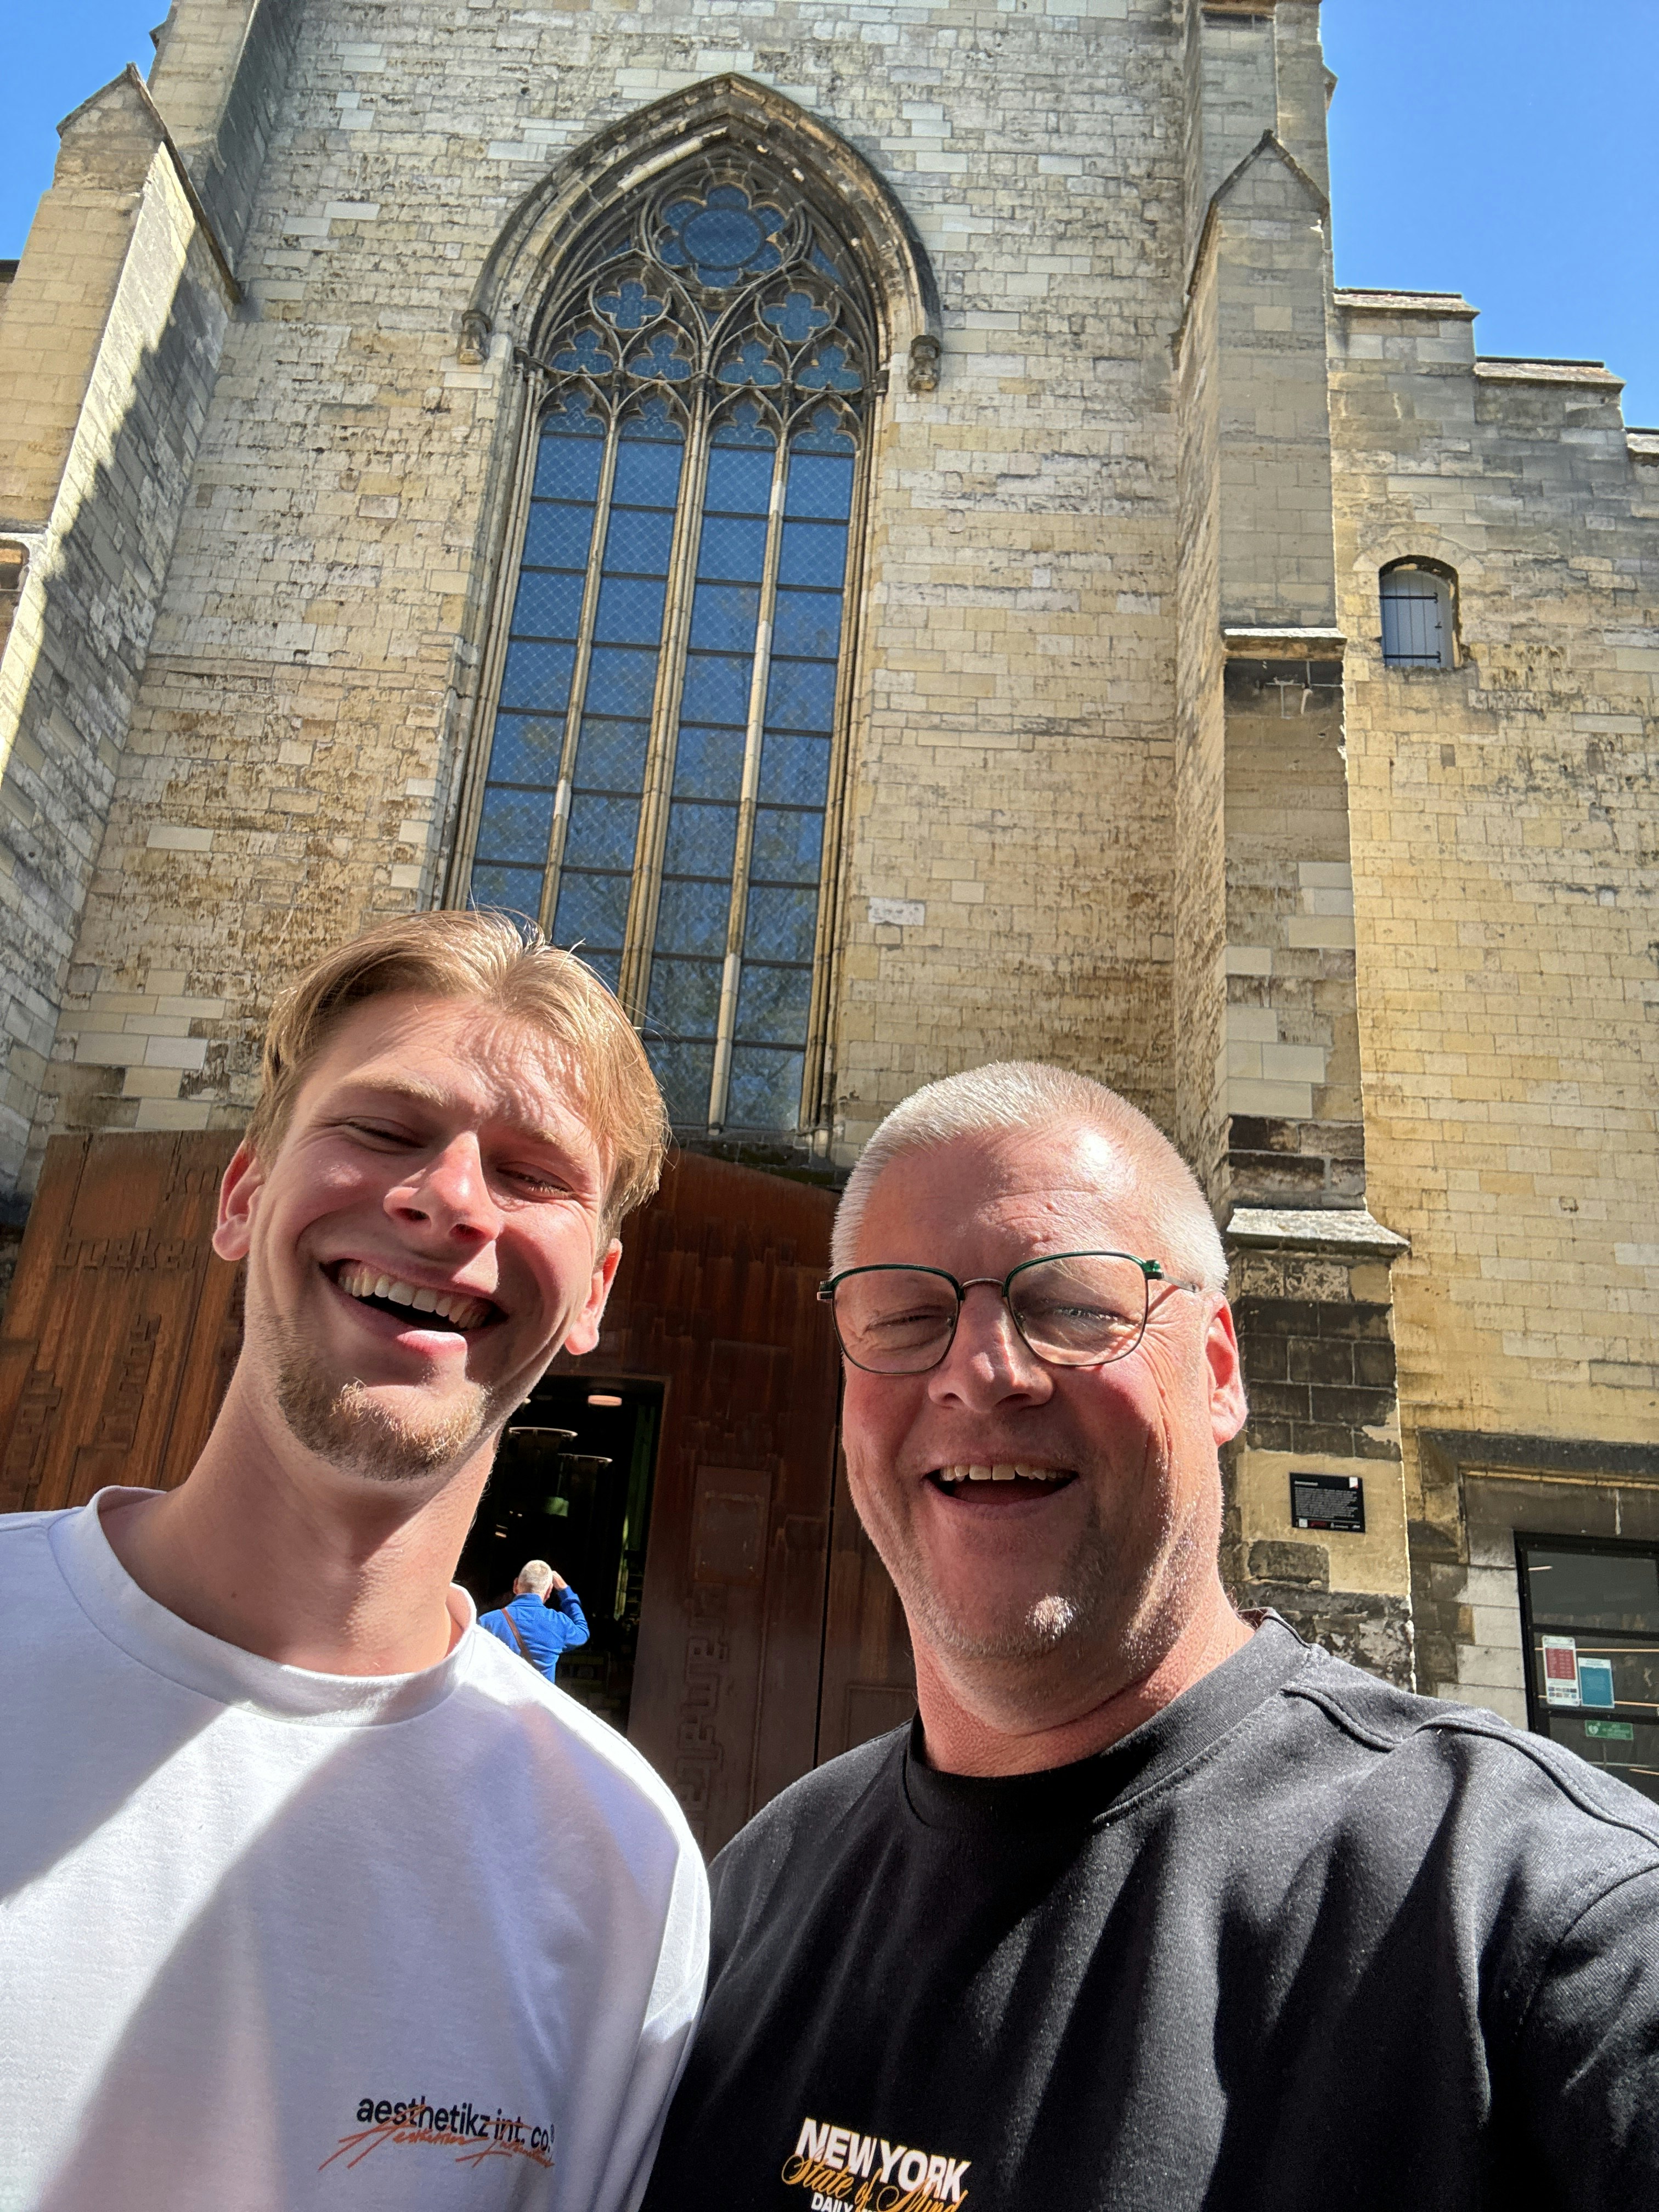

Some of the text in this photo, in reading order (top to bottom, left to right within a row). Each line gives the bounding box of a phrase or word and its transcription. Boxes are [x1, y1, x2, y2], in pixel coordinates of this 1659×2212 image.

[357, 2096, 490, 2137] aesthetikz
[494, 2108, 525, 2145] int.
[782, 2146, 854, 2199] State
[854, 2168, 882, 2212] of
